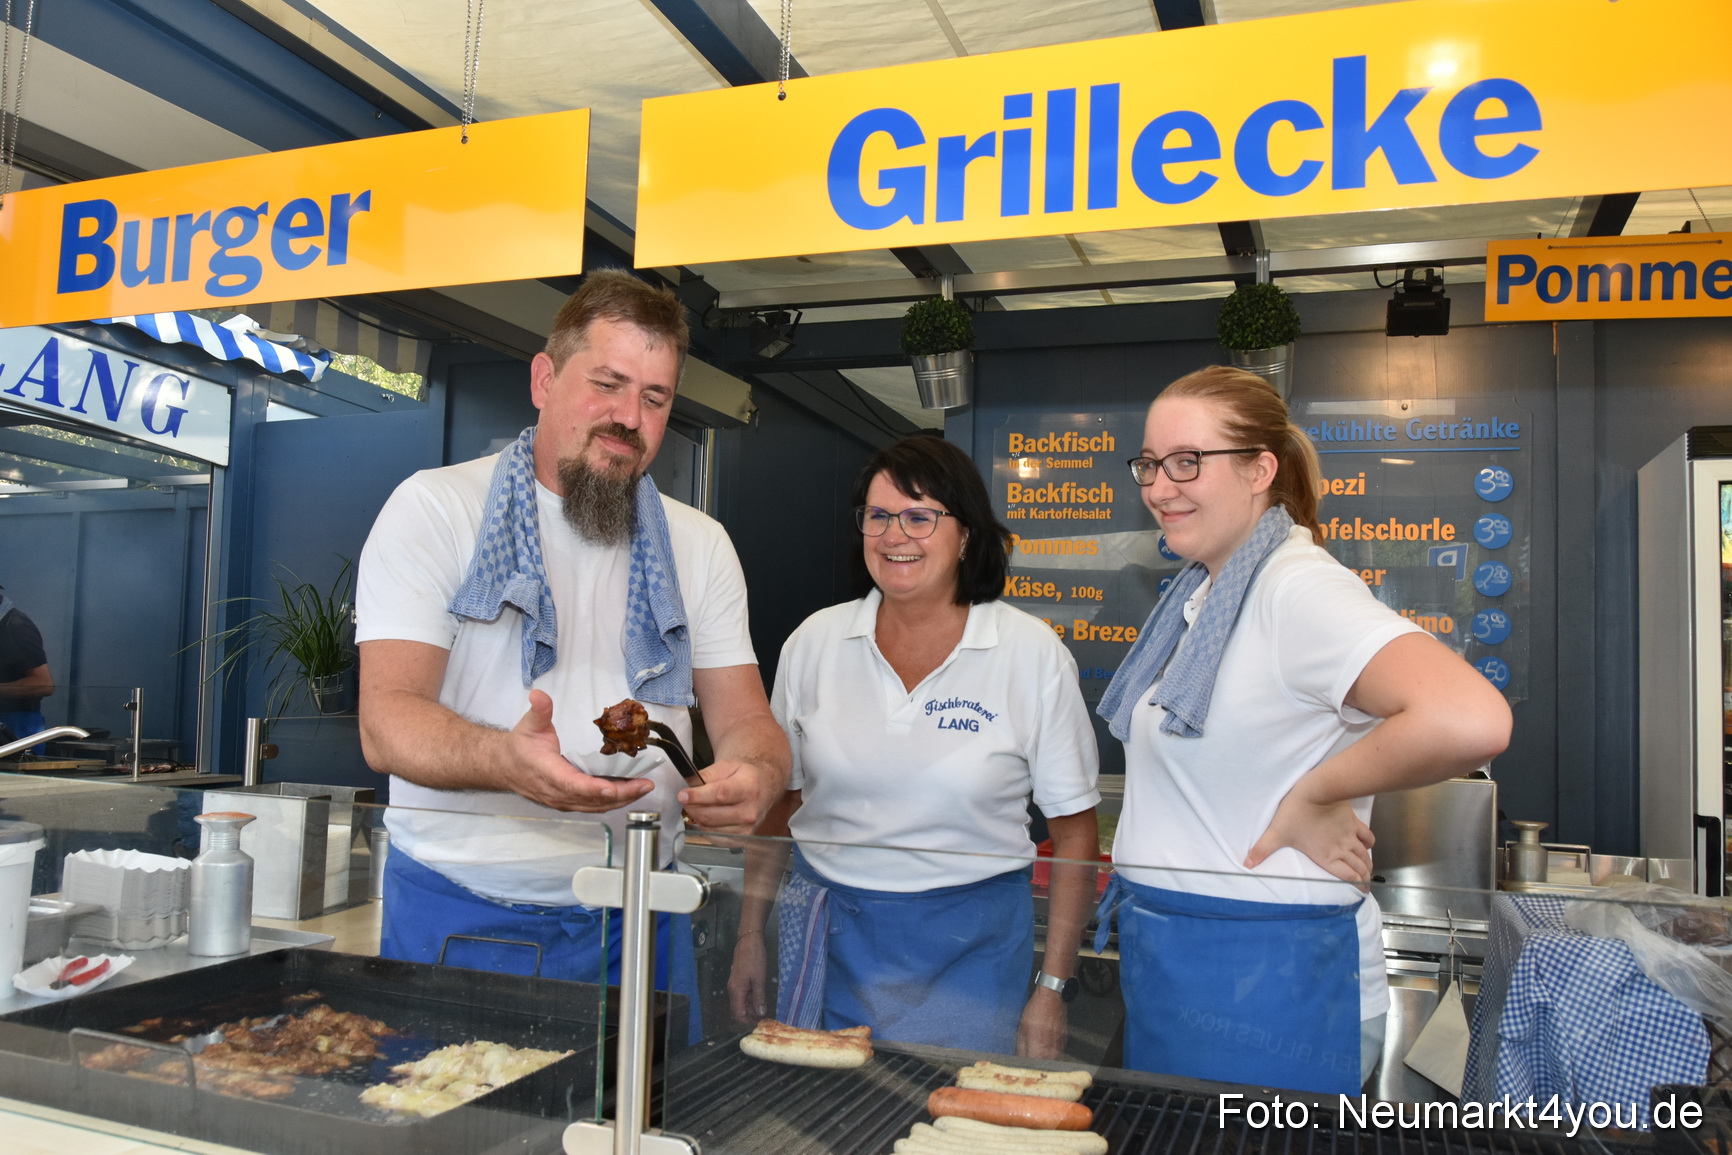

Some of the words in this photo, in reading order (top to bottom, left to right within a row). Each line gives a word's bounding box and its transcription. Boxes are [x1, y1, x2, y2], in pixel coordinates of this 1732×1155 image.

[827, 55, 1542, 230] Grillecke
[57, 189, 371, 297] Burger
[1497, 254, 1732, 304] Pomme
[0, 336, 190, 438] ANG
[1302, 418, 1398, 442] ekühlte
[1405, 416, 1520, 440] Getränke
[1009, 431, 1115, 453] Backfisch
[1008, 457, 1020, 469] in
[1023, 457, 1042, 469] der
[1046, 456, 1093, 469] Semmel
[1007, 482, 1113, 503] Backfisch
[1007, 507, 1026, 519] mit
[1029, 507, 1111, 519] Kartoffelsalat
[1005, 533, 1098, 555] Pommes
[1004, 576, 1062, 602] Käse,
[1071, 586, 1104, 601] 100g
[1073, 619, 1138, 642] Breze
[925, 696, 998, 722] Fischbraterei
[938, 717, 979, 732] LANG
